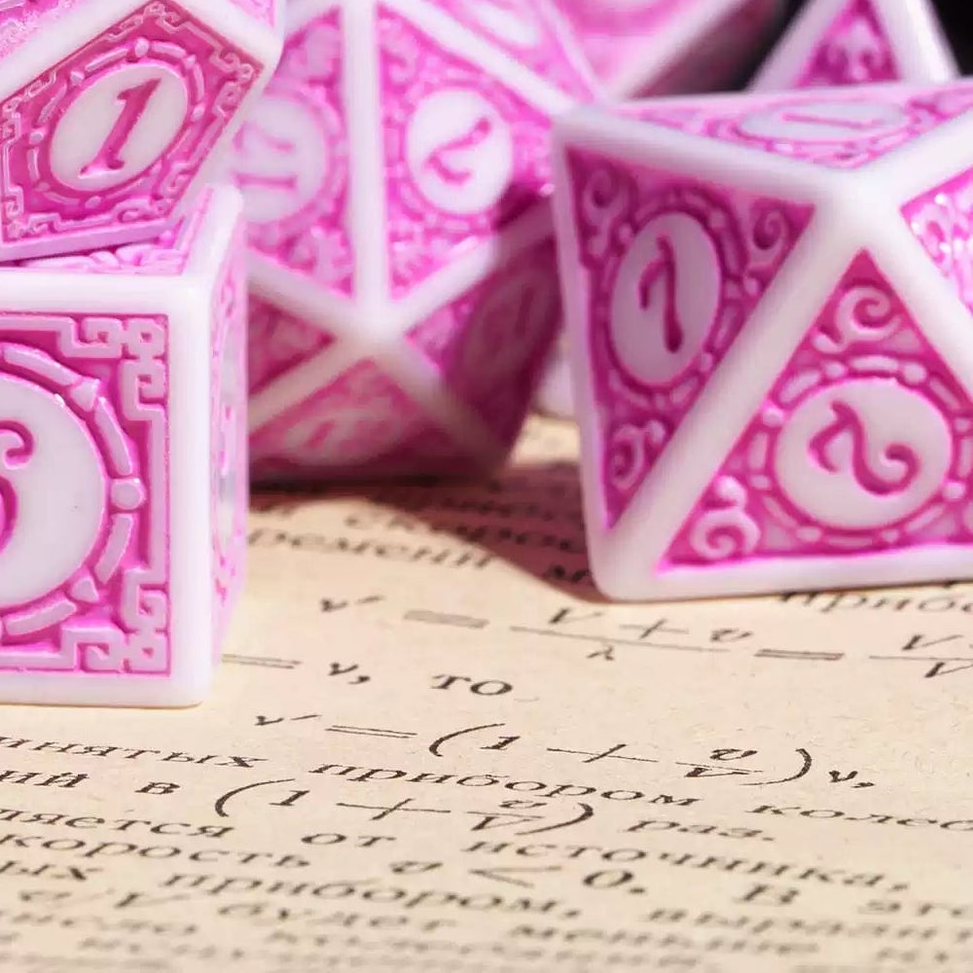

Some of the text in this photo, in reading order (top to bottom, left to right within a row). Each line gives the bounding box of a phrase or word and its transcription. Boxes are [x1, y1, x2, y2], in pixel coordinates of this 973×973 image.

[77, 79, 163, 179] 1
[809, 400, 921, 497] 2
[431, 673, 514, 696] то
[308, 763, 704, 808] прибором
[299, 832, 397, 848] от
